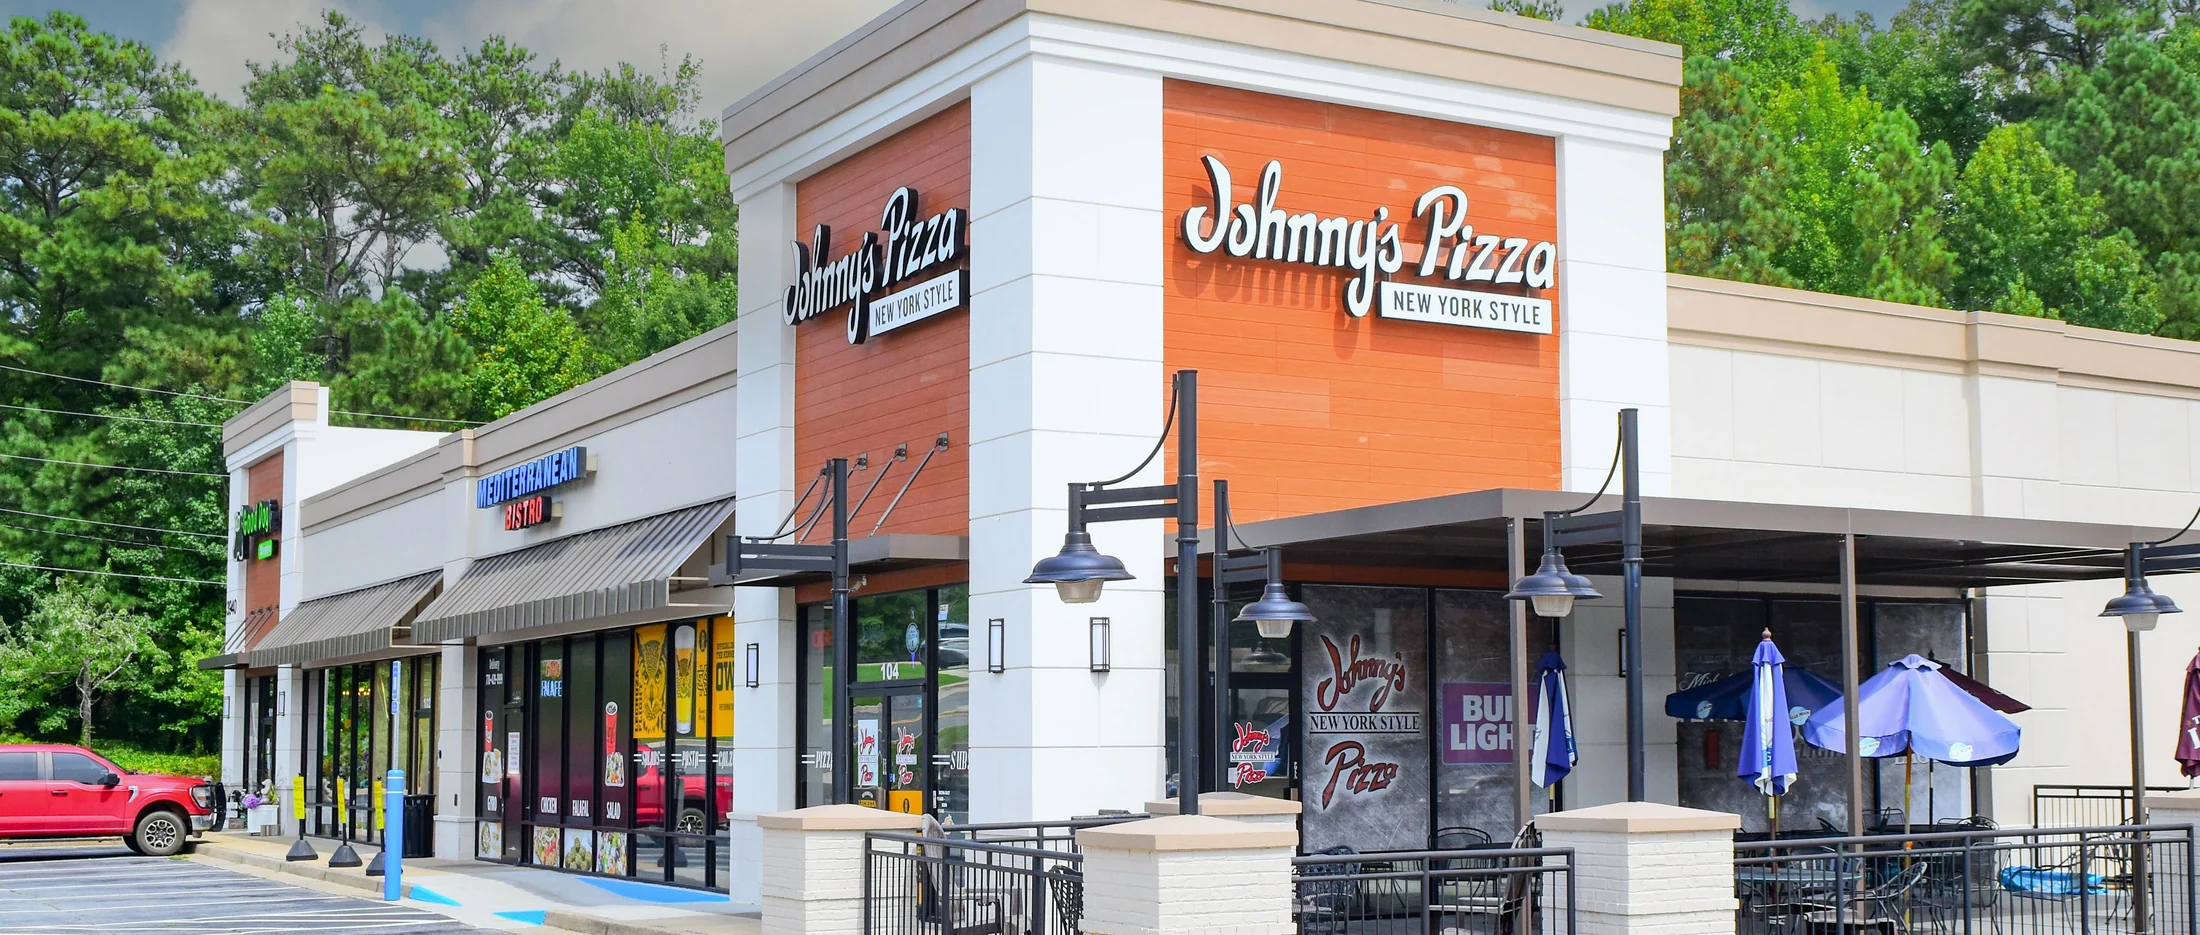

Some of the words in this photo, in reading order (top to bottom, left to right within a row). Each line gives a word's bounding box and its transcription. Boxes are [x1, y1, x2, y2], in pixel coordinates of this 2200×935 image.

[1184, 154, 1403, 318] Johnny's
[1413, 185, 1557, 289] Pizza
[782, 223, 876, 345] Johnny's
[881, 186, 957, 288] Pizza
[875, 303, 895, 328] NEW
[897, 294, 921, 318] YORK
[923, 280, 953, 310] STYLE
[1393, 290, 1432, 314] NEW
[1438, 295, 1483, 320] YORK
[1489, 302, 1541, 326] STYLE
[477, 446, 579, 509] MEDITERRANEAN
[505, 496, 543, 531] BISTRO
[880, 662, 899, 681] 104
[1318, 634, 1406, 712] Johnny's
[1310, 715, 1341, 730] NEW
[1342, 715, 1378, 730] YORK
[1380, 715, 1420, 730] STYLE
[1322, 740, 1399, 811] Pizza
